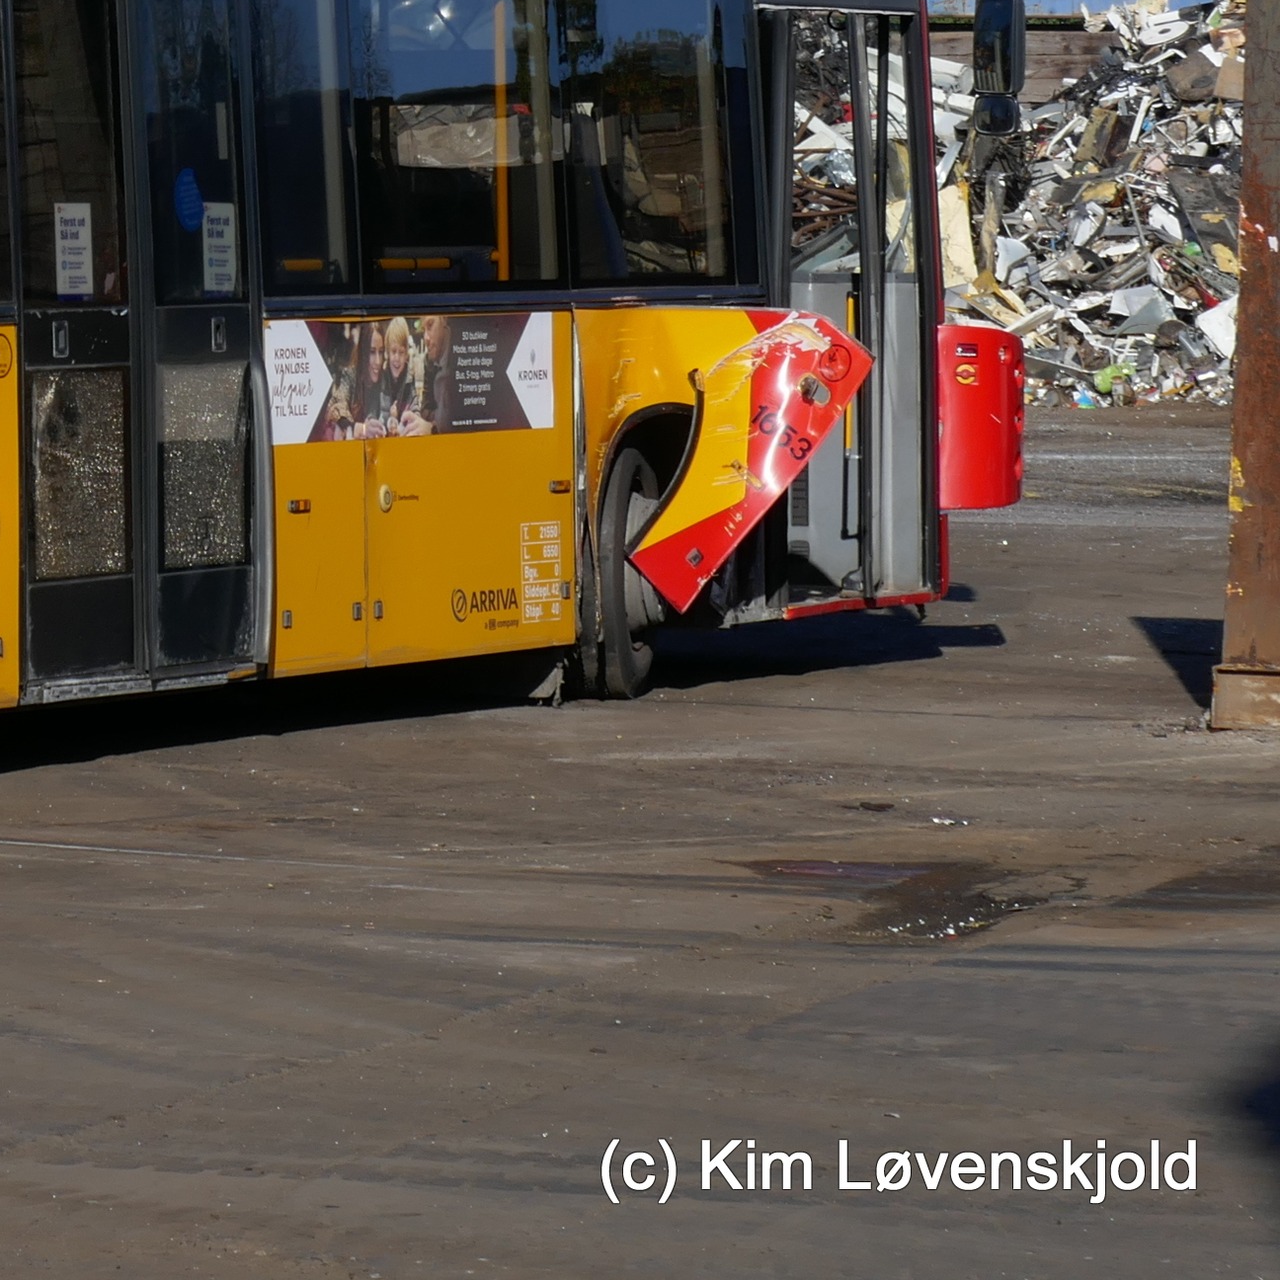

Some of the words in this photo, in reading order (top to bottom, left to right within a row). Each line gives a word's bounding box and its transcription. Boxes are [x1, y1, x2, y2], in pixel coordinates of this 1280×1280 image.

[274, 348, 307, 359] KRONEN
[274, 363, 310, 374] VANLØSE
[518, 370, 548, 380] KRONEN
[275, 406, 286, 416] TIL
[288, 405, 308, 416] ALLE
[751, 404, 813, 460] 1653
[470, 588, 518, 613] ARRIVA
